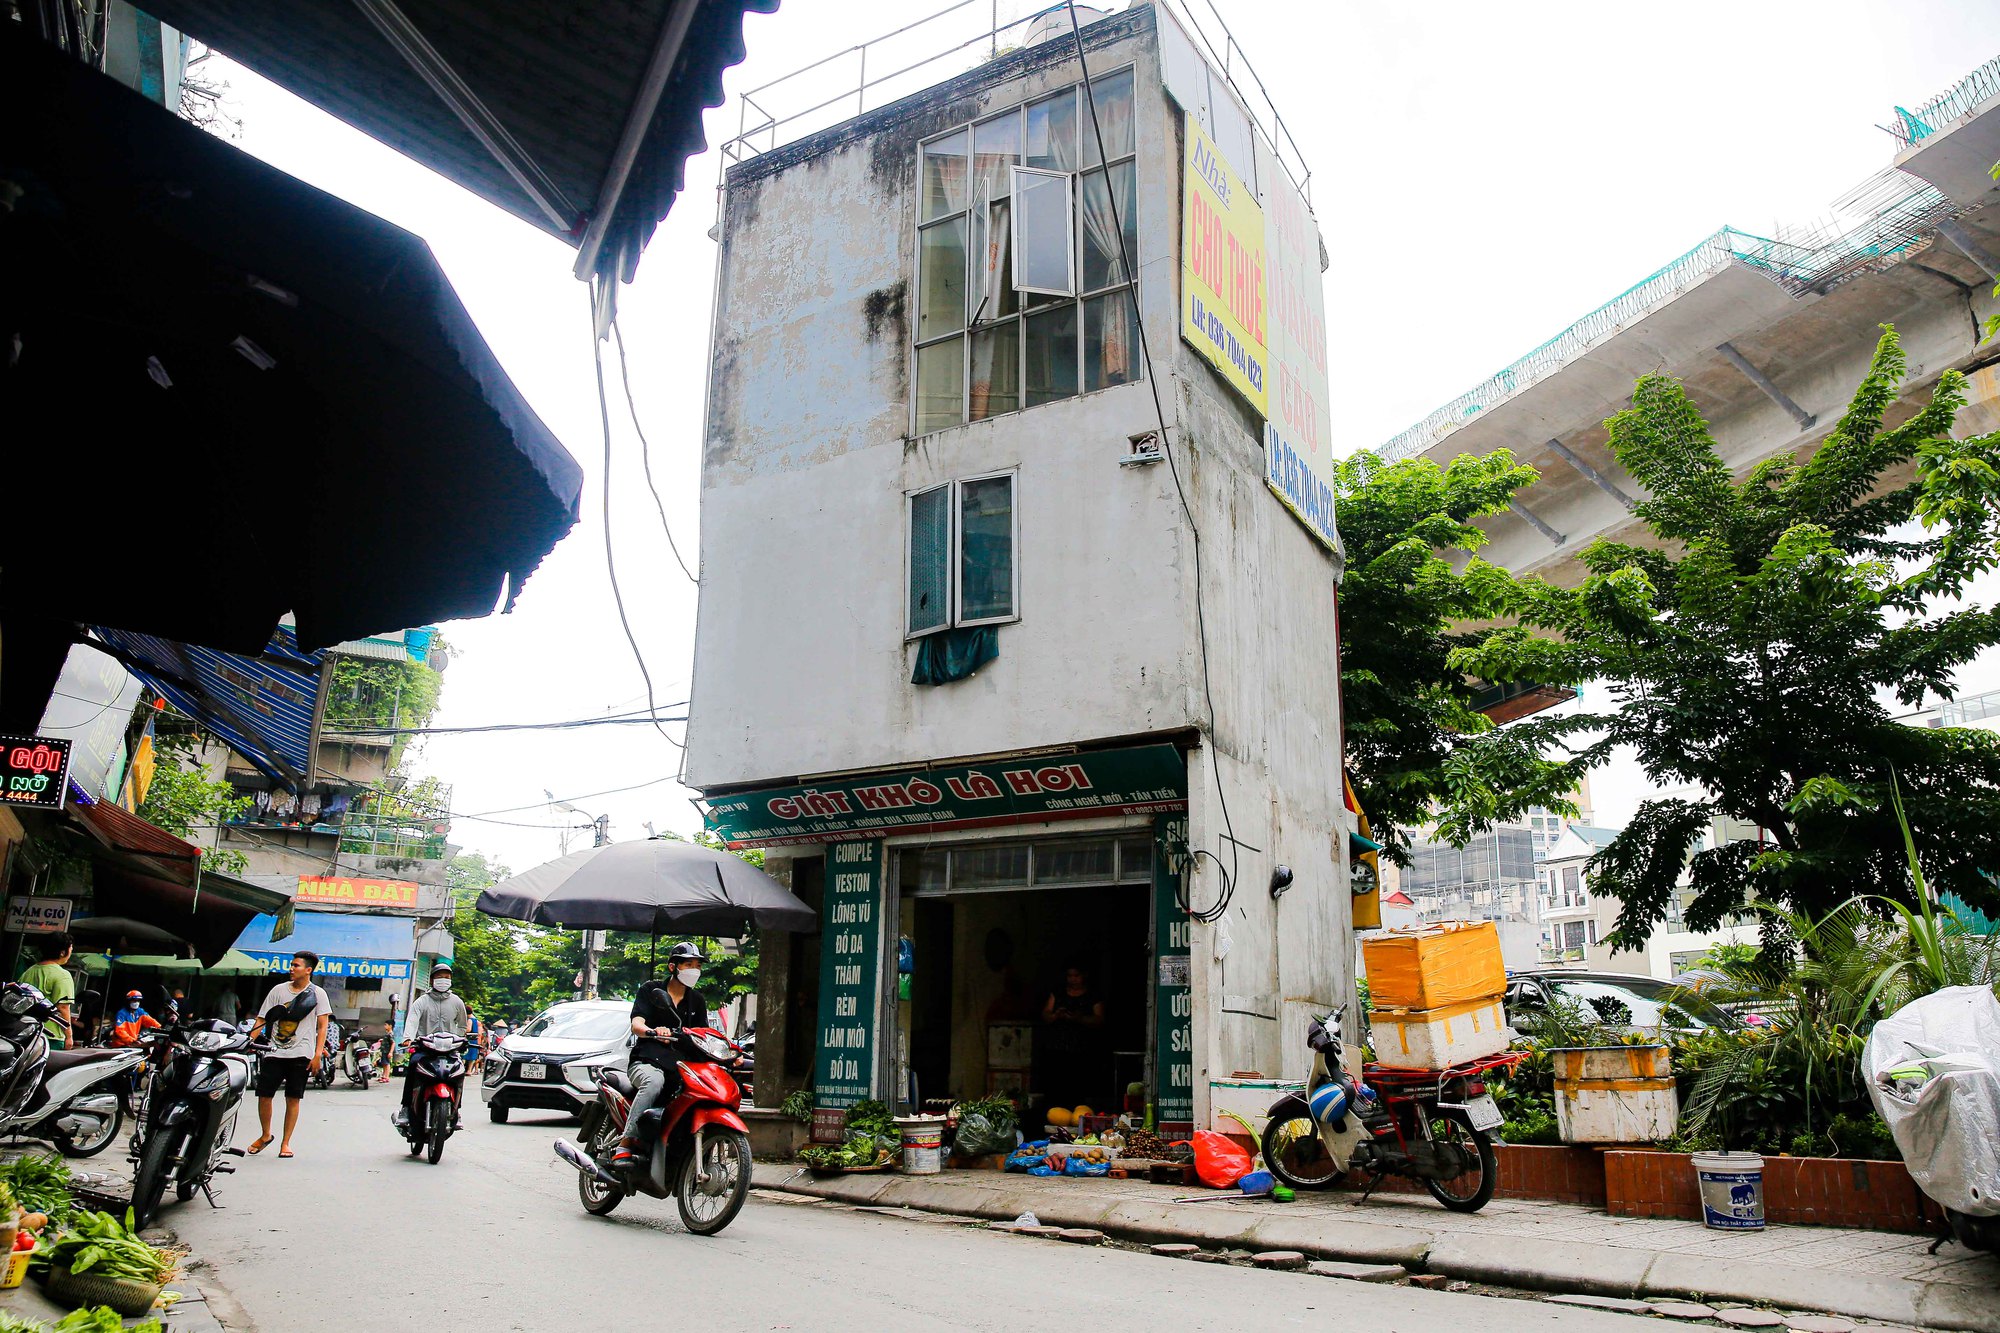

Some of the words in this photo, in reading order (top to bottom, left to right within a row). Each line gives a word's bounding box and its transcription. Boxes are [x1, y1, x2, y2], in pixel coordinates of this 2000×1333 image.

[1193, 136, 1232, 204] Nhà:
[1191, 188, 1223, 300] CHO
[1227, 229, 1263, 345] THUÊ
[1191, 293, 1206, 334] LH:
[1208, 311, 1225, 351] 036
[1226, 330, 1247, 375] 7044
[1247, 354, 1263, 393] 023
[10, 745, 61, 774] GỘI
[6, 791, 38, 801] 4444
[767, 789, 854, 820] GIẶT
[852, 776, 943, 811] KHÔ
[945, 770, 1004, 800] LÀ
[1002, 764, 1093, 796] HƠI
[1045, 797, 1074, 810] CÔNG
[1074, 793, 1101, 807] NGHỆ
[1129, 788, 1152, 802] TÂN
[1151, 786, 1178, 799] TIẾN
[825, 820, 850, 831] NGAY
[854, 816, 883, 828] KHÔNG
[884, 815, 902, 826] QUA
[902, 812, 932, 824] TRUNG
[931, 810, 956, 820] GIAN
[835, 842, 872, 863] COMPLE
[297, 880, 355, 898] NHÀ
[363, 881, 415, 901] ĐẤT
[835, 872, 870, 893] VESTON
[832, 900, 856, 924] LÔNG
[858, 900, 871, 923] VŨ
[835, 928, 849, 954] ĐỒ
[850, 934, 863, 954] DA
[348, 960, 386, 977] TÔM
[835, 957, 861, 985] THẢM
[835, 995, 857, 1017] RÈM
[824, 1024, 845, 1048] LÀM
[847, 1021, 865, 1048] MỚI
[830, 1053, 844, 1080] ĐỒ
[845, 1060, 858, 1080] DA
[1171, 1064, 1191, 1087] KH
[1733, 1207, 1756, 1217] C.K
